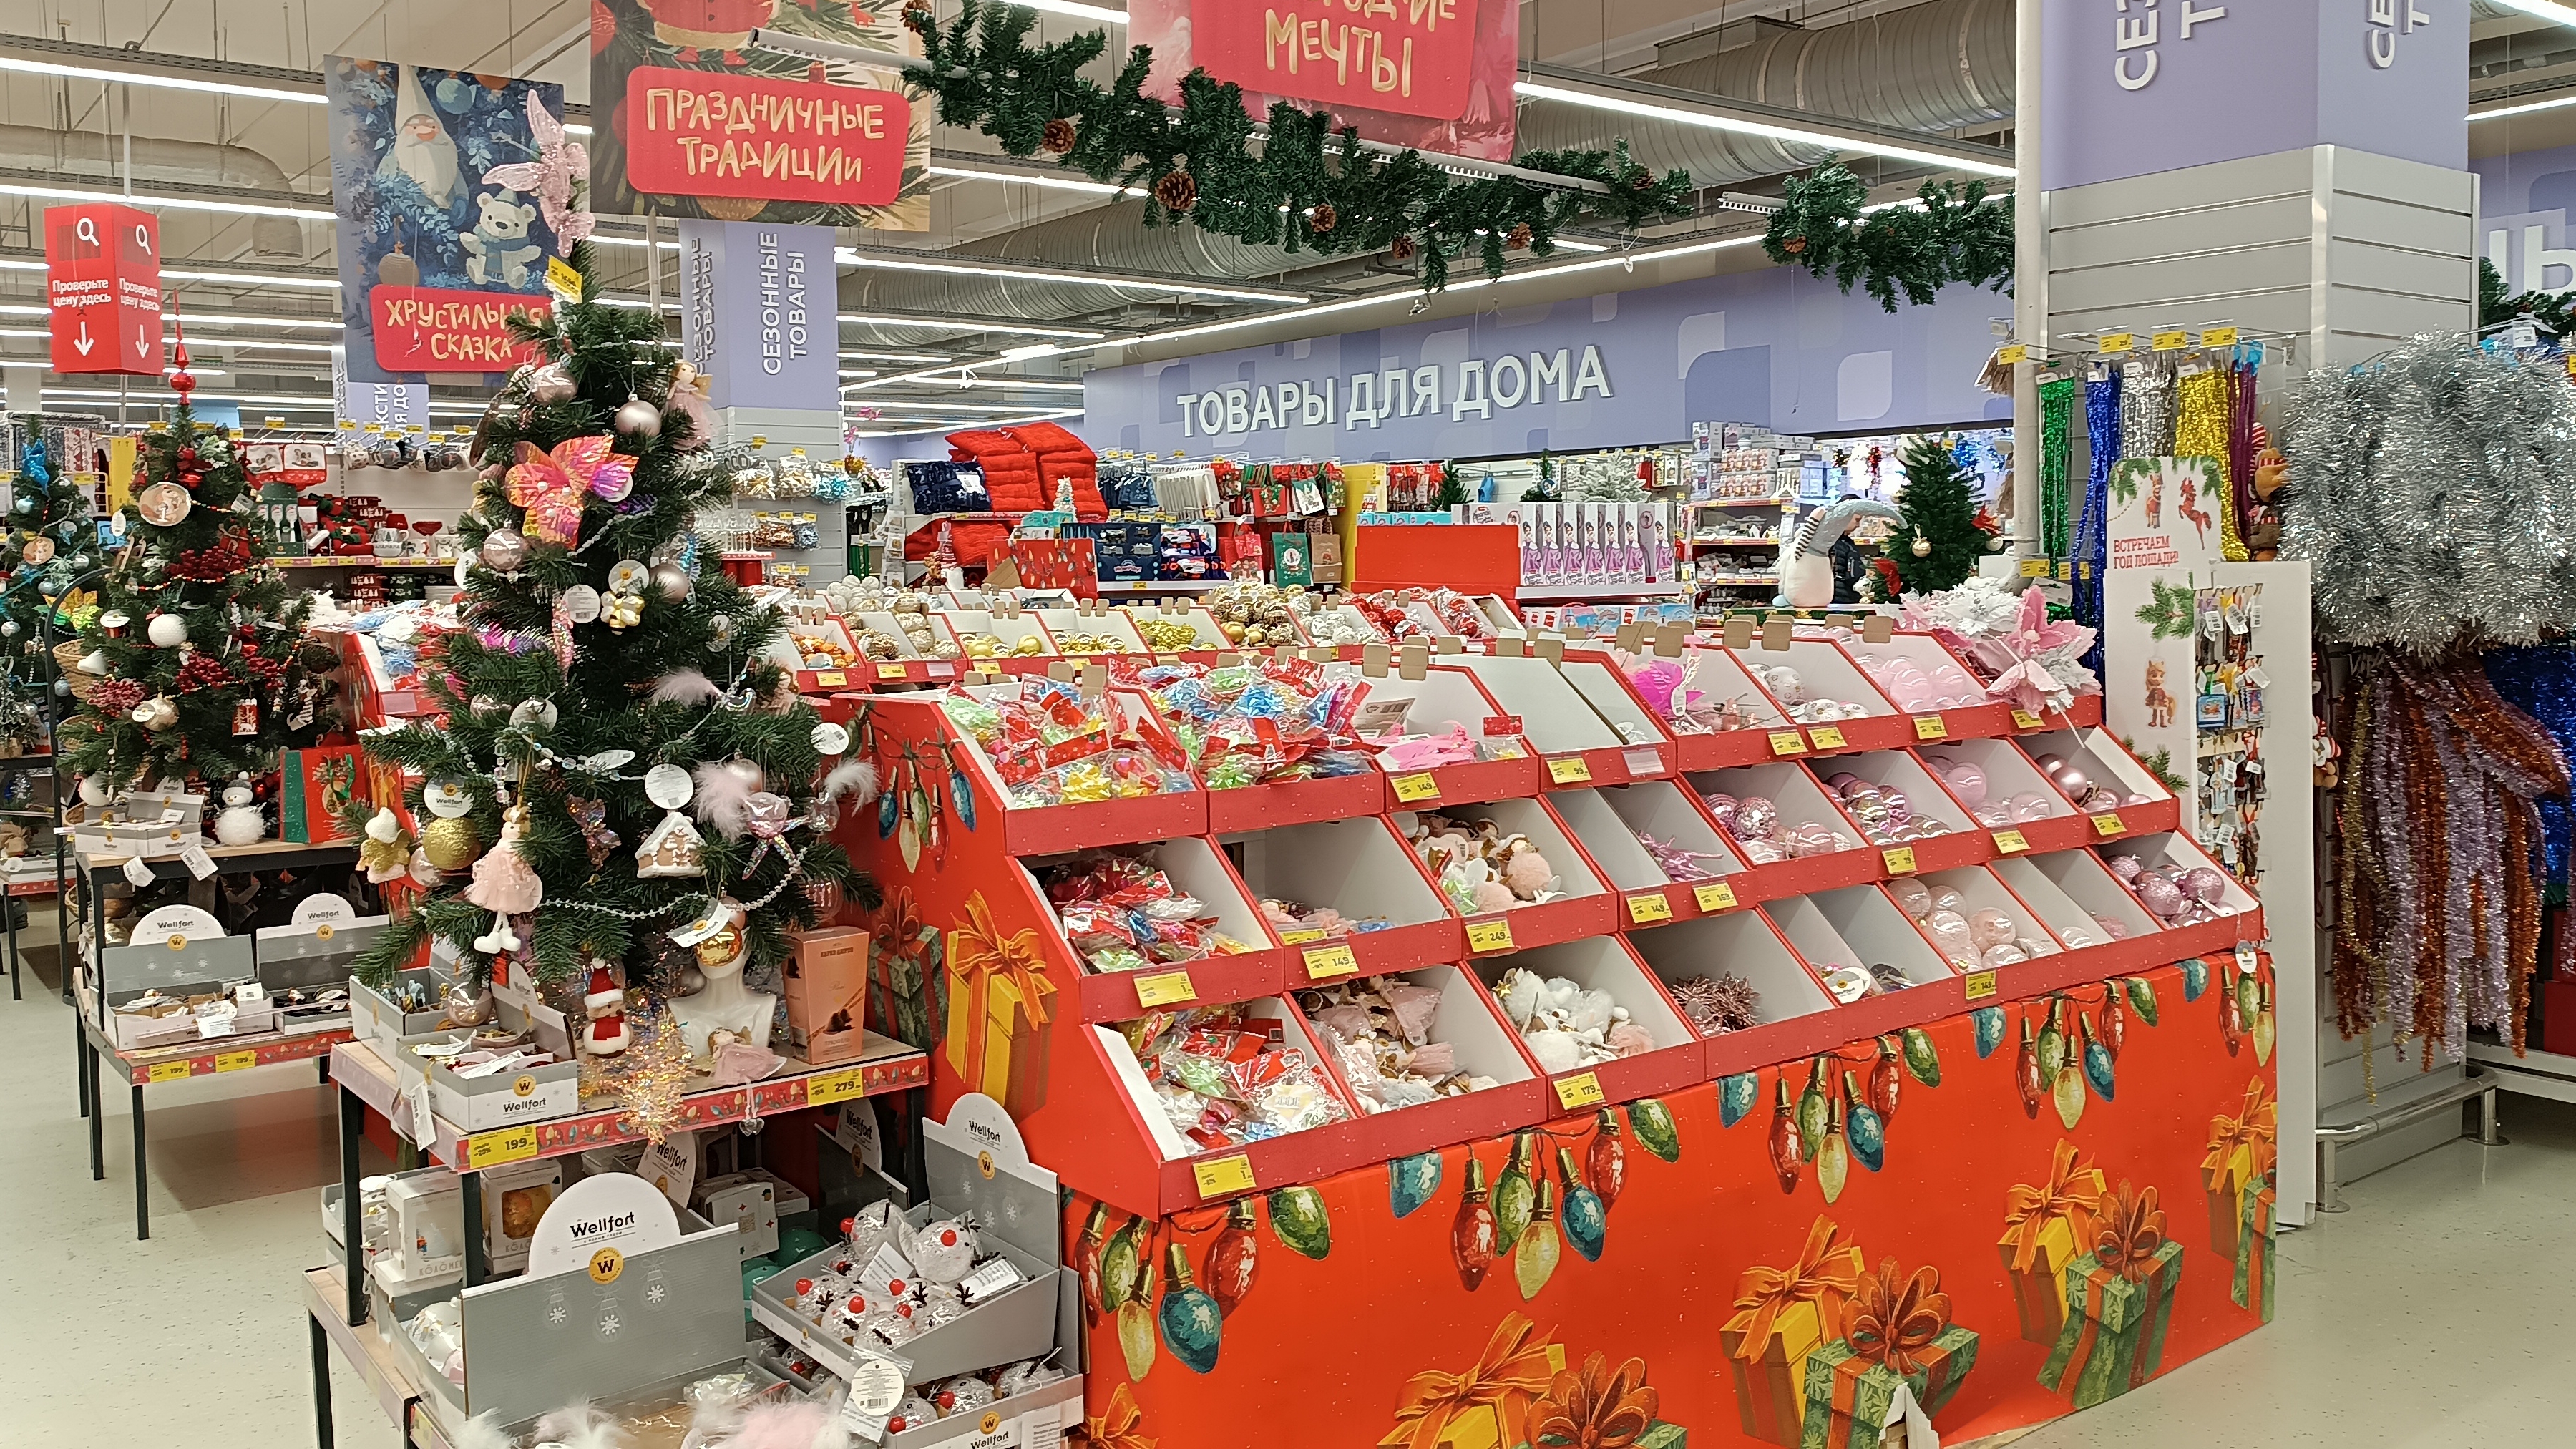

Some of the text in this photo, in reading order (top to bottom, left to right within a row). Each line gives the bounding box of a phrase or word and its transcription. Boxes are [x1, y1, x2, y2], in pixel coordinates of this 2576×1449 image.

[1265, 9, 1412, 97] МЕЧТЫ
[647, 88, 885, 139] ПРАЗДНИЧНЫЕ
[677, 137, 862, 185] ТРАДИЦИИ
[52, 279, 109, 294] Проверьте
[119, 278, 158, 297] Проверьте
[53, 294, 112, 308] цену здесь
[120, 295, 160, 311] цену здесь
[701, 250, 716, 360] ТОВАРЫ
[759, 232, 782, 375] СЕЗОННЫЕ
[786, 252, 808, 360] ТОВАРЫ
[431, 333, 512, 363] СКАЗКА
[1176, 345, 1614, 437] ТОВАРЫ ДЛЯ ДОМА
[2114, 536, 2170, 552] ВСТРЕЧАЕМ
[2114, 551, 2179, 569] ГОД ЛОШАДИ!
[157, 919, 194, 930] Wellfort
[307, 911, 339, 921] Wellfort
[503, 1097, 546, 1113] Wellfort
[969, 1120, 1000, 1143] Wellfort
[656, 1141, 688, 1171] Wellfort
[570, 1211, 635, 1238] Wellfort
[970, 1430, 1009, 1449] Wellfort
